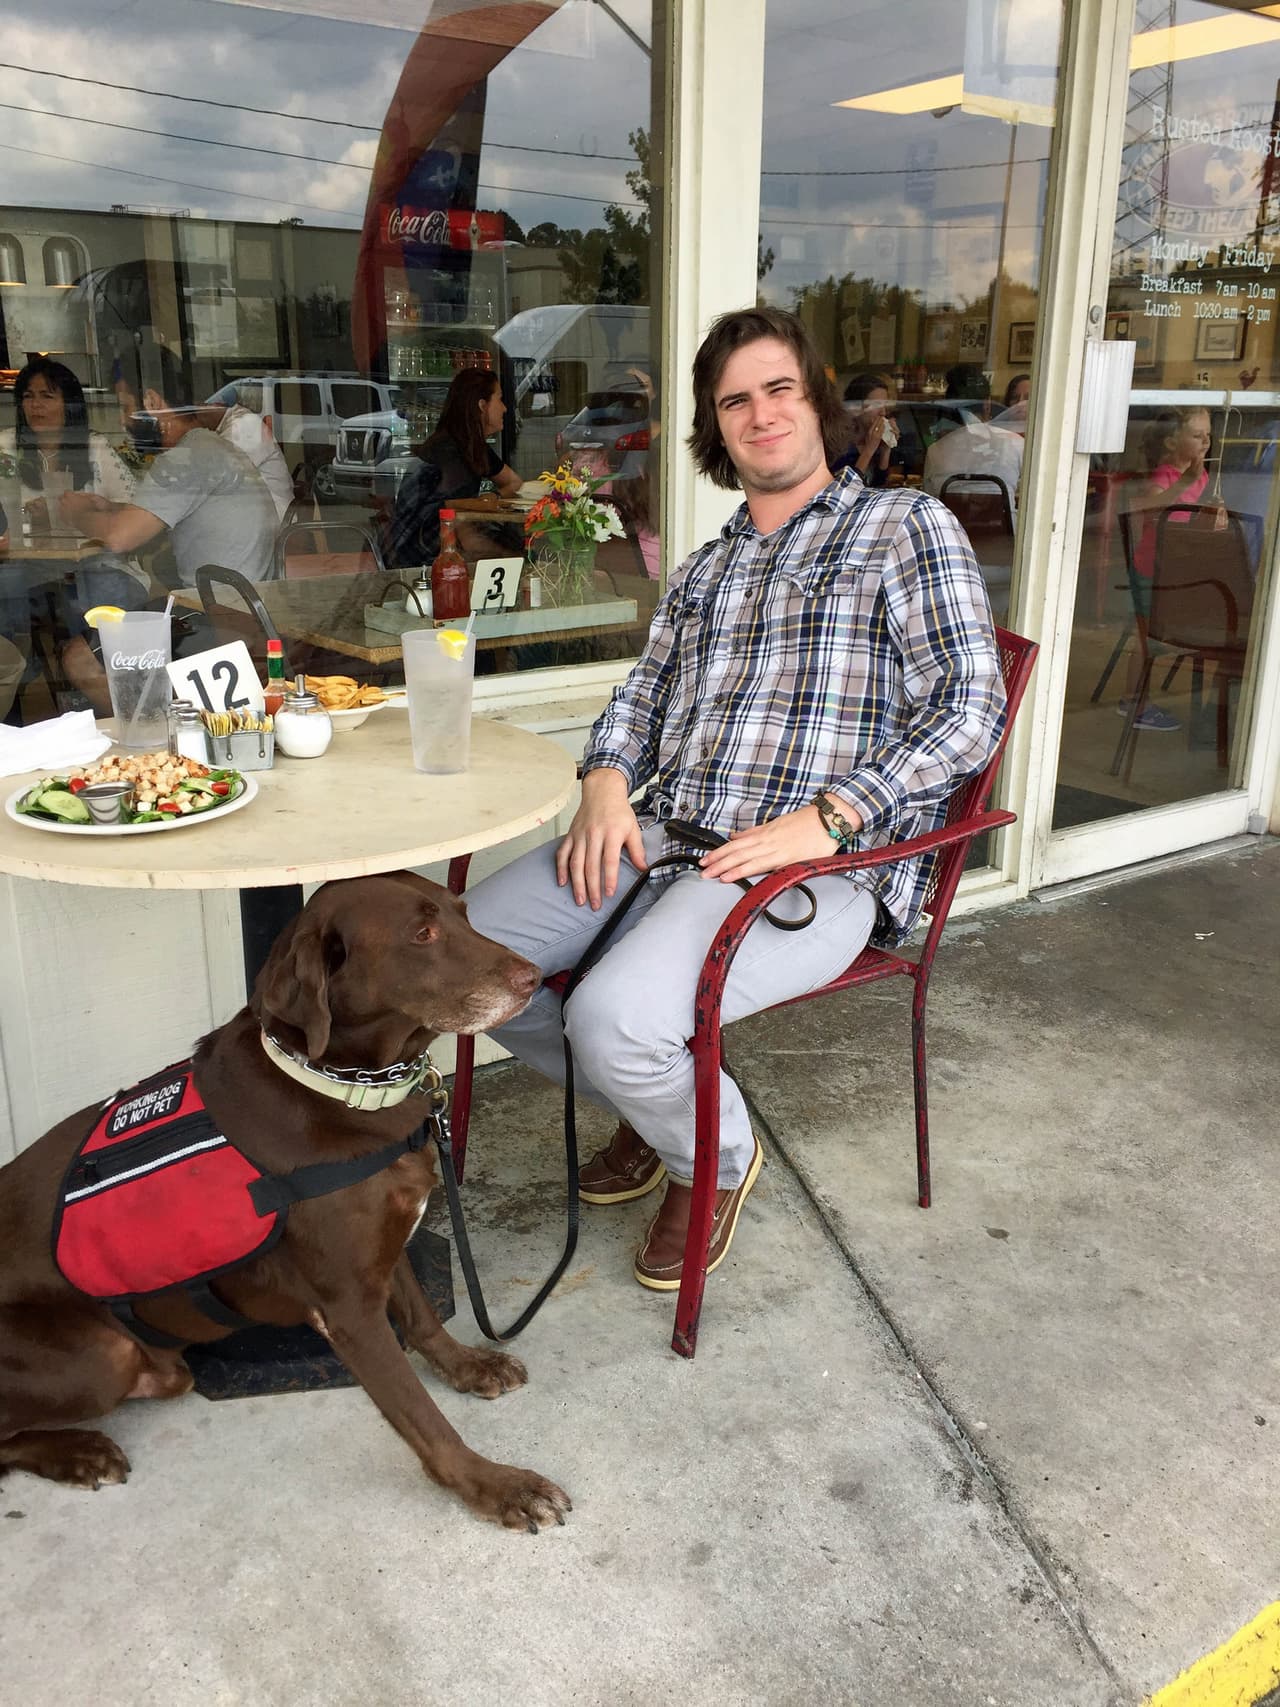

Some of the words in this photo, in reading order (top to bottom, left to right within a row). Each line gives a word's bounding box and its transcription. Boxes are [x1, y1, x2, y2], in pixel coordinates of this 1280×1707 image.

[1152, 104, 1220, 144] Rusted
[1151, 237, 1209, 267] Monday
[1223, 242, 1275, 273] Friday
[1140, 274, 1203, 294] Breakfast
[1261, 287, 1276, 300] am
[1144, 299, 1182, 317] Lunch
[1223, 308, 1238, 320] am
[1247, 304, 1255, 321] 2
[1256, 309, 1271, 325] pm
[486, 567, 506, 600] 3
[111, 649, 166, 671] Coca-Cola
[187, 660, 250, 714] 12
[112, 1115, 128, 1132] DO
[130, 1106, 151, 1123] NOT
[152, 1095, 175, 1115] PET
[115, 1091, 158, 1117] WORKING
[158, 1081, 181, 1100] DOG
